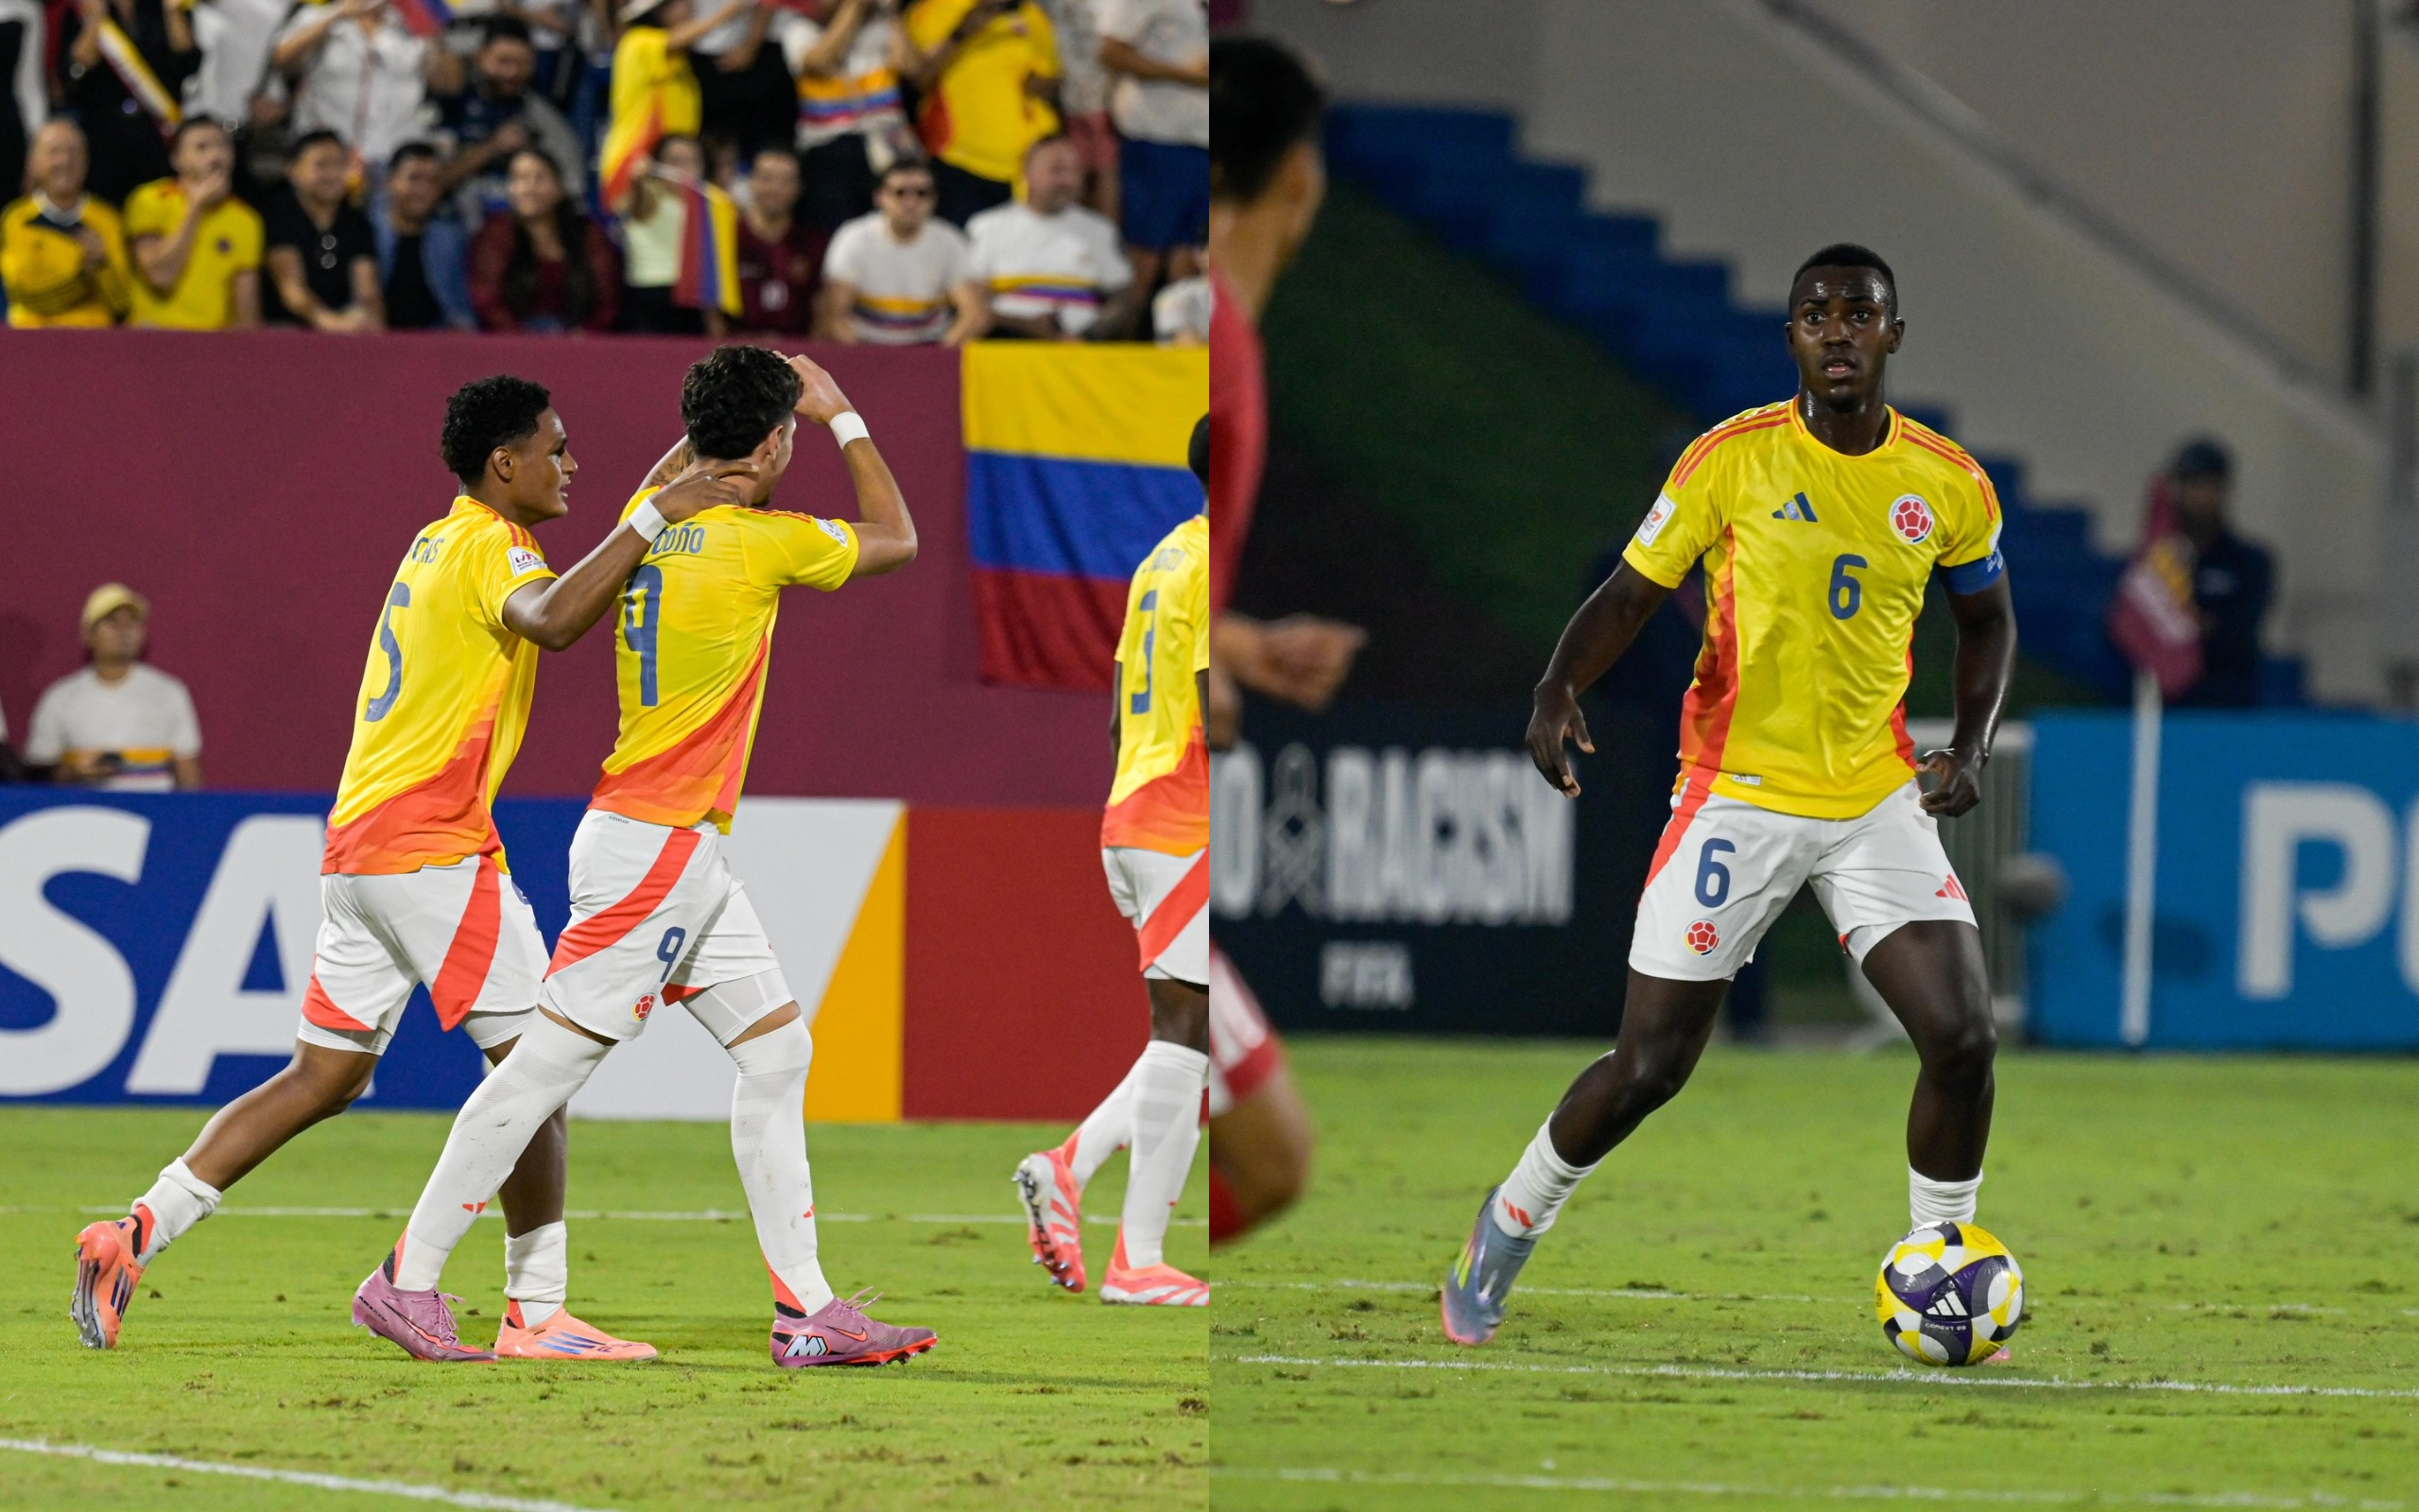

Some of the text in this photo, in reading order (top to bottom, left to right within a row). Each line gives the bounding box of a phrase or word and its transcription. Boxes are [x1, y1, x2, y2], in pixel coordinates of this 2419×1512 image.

[624, 564, 663, 706] 9
[1828, 553, 1868, 620] 6
[363, 581, 411, 722] 5
[1325, 747, 1574, 925] RACISM
[1694, 837, 1736, 908] 6
[656, 926, 686, 983] 9
